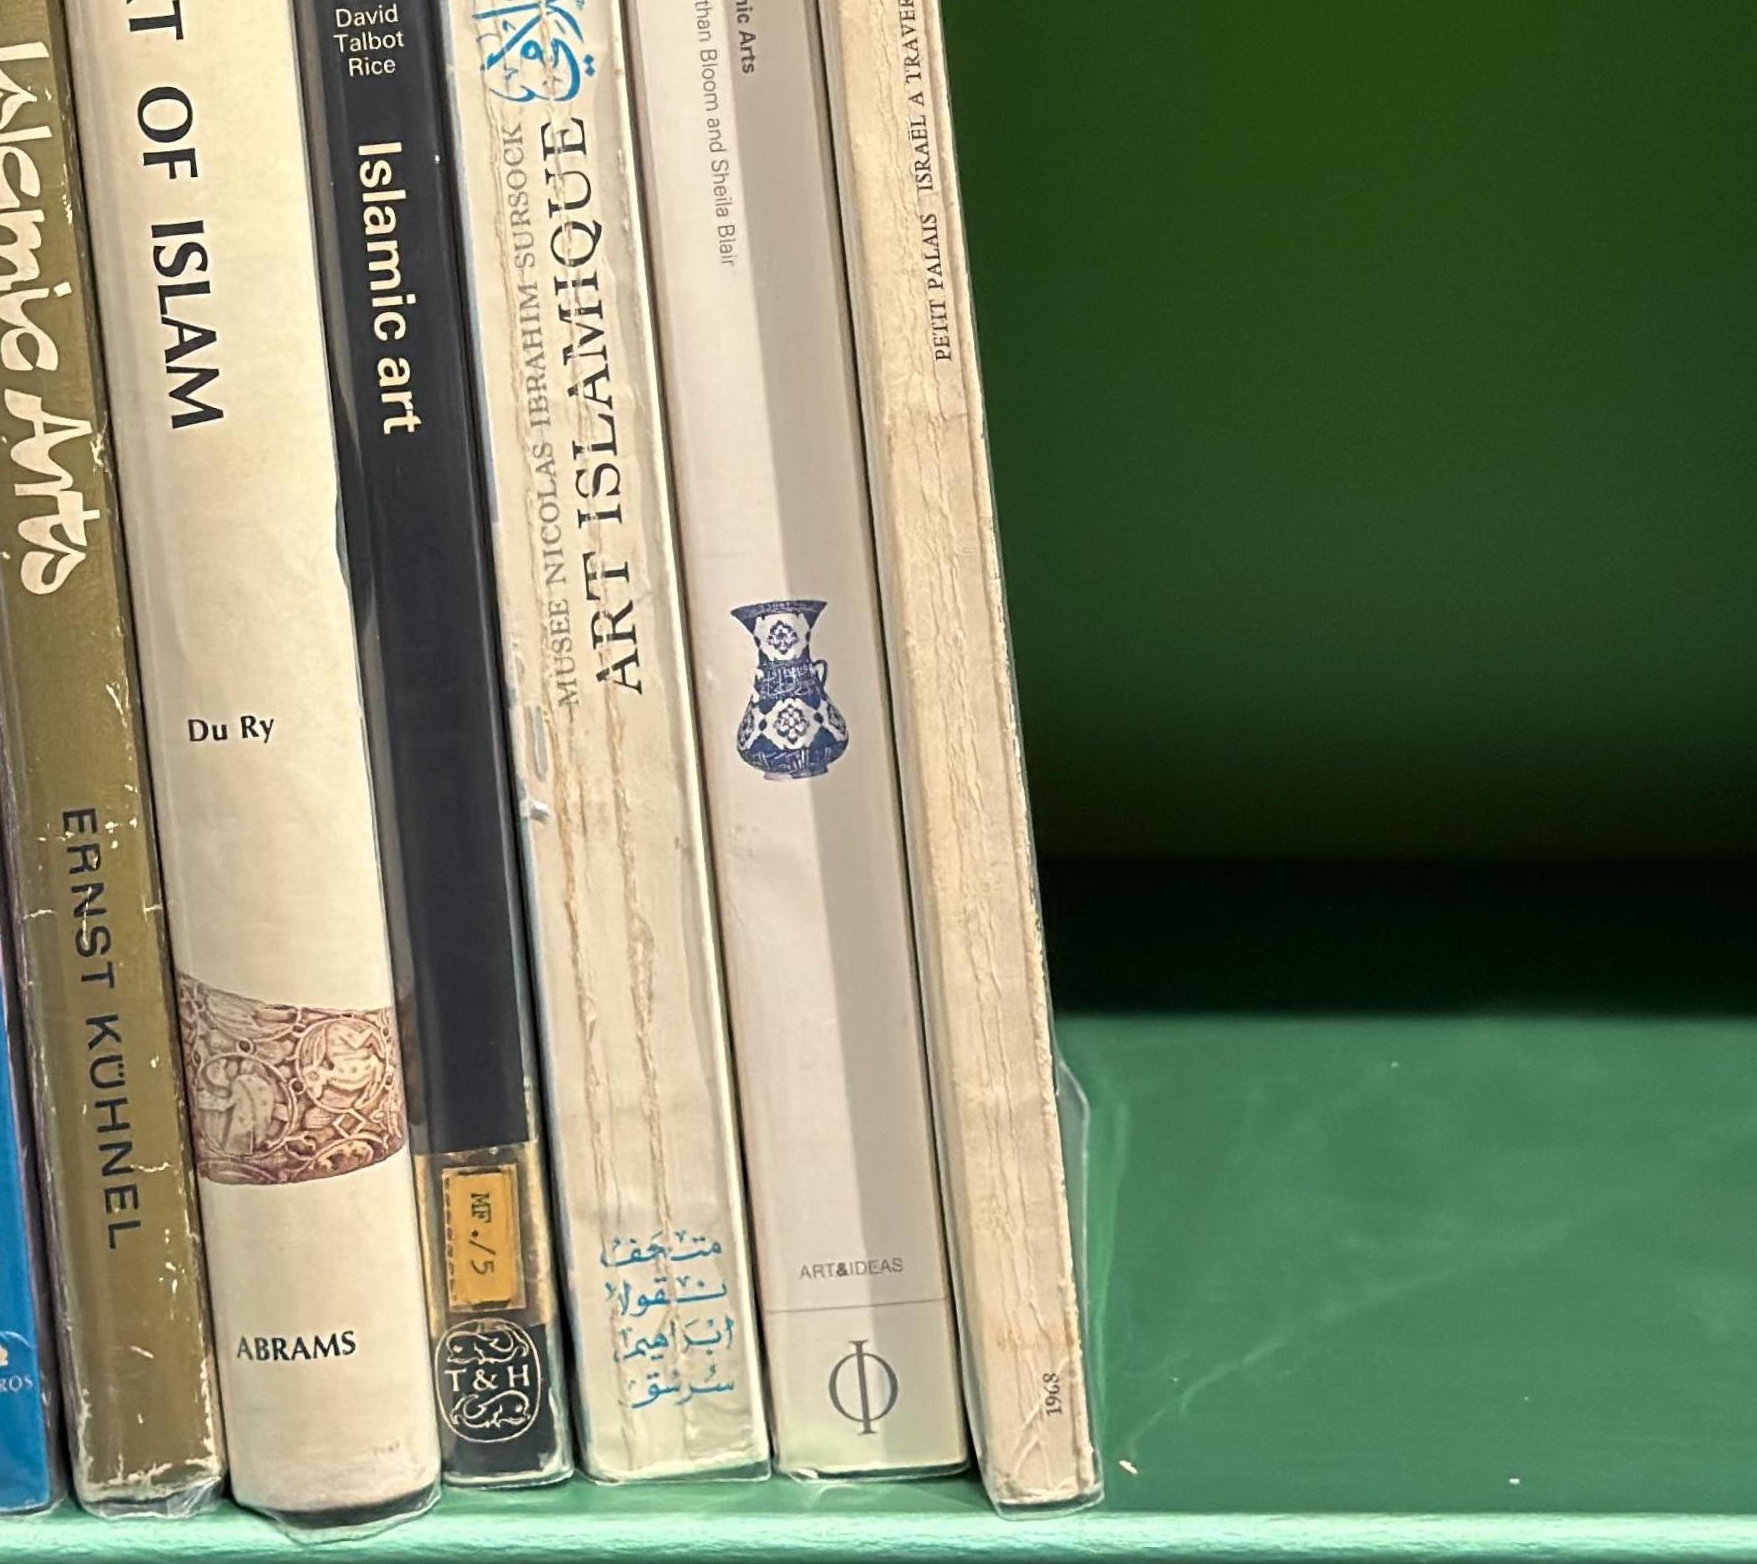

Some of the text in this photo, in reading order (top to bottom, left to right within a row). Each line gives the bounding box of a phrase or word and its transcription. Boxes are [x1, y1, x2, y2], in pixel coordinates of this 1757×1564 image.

[333, 30, 405, 54] Talbot
[335, 4, 399, 28] David
[348, 57, 396, 77] Rice
[738, 27, 757, 75] Arts
[700, 48, 720, 112] Bloom
[907, 90, 926, 109] A
[135, 84, 199, 180] OF
[706, 115, 726, 154] and
[908, 114, 935, 192] ISRAËL
[711, 158, 732, 219] Sheila
[717, 222, 736, 268] Blair
[921, 211, 946, 292] PALAIS
[357, 140, 422, 436] Islamic art
[150, 219, 225, 430] ISLAM
[929, 298, 953, 363] PETIT
[500, 120, 580, 708] MUSEE NICOLAS IBRAHIM SURSOCK
[539, 115, 643, 695] ART ISLAMIQUE
[2, 387, 101, 596] Arts
[187, 714, 275, 744] Du Ry
[61, 806, 142, 1251] ERNST KÜHNEL
[799, 1256, 904, 1281] ART&IDEAS
[236, 1329, 356, 1362] ABRAMS
[444, 1364, 531, 1393] T & H
[1044, 1371, 1064, 1418] 1968
